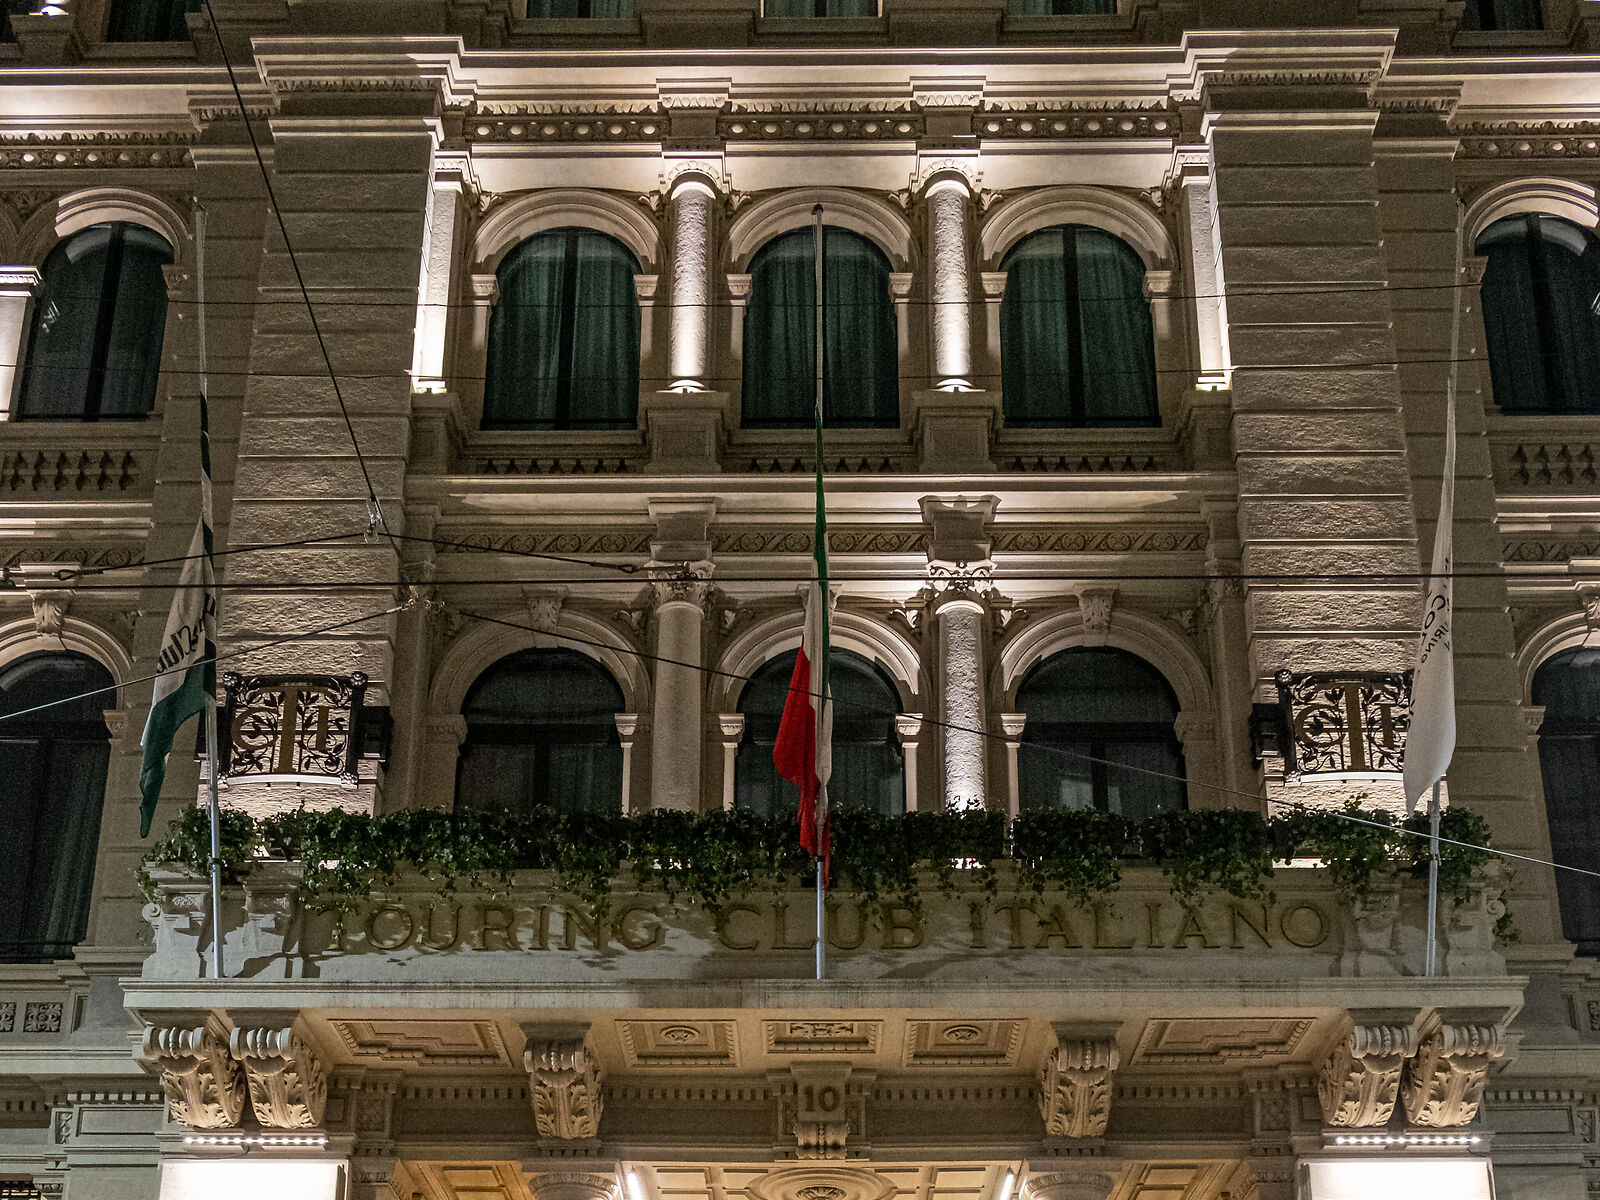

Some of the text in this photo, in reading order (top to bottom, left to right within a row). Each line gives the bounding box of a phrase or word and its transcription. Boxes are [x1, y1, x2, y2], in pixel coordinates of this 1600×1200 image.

[320, 902, 1329, 951] TOURING CLUB ITALIANO
[804, 1085, 840, 1112] 10
